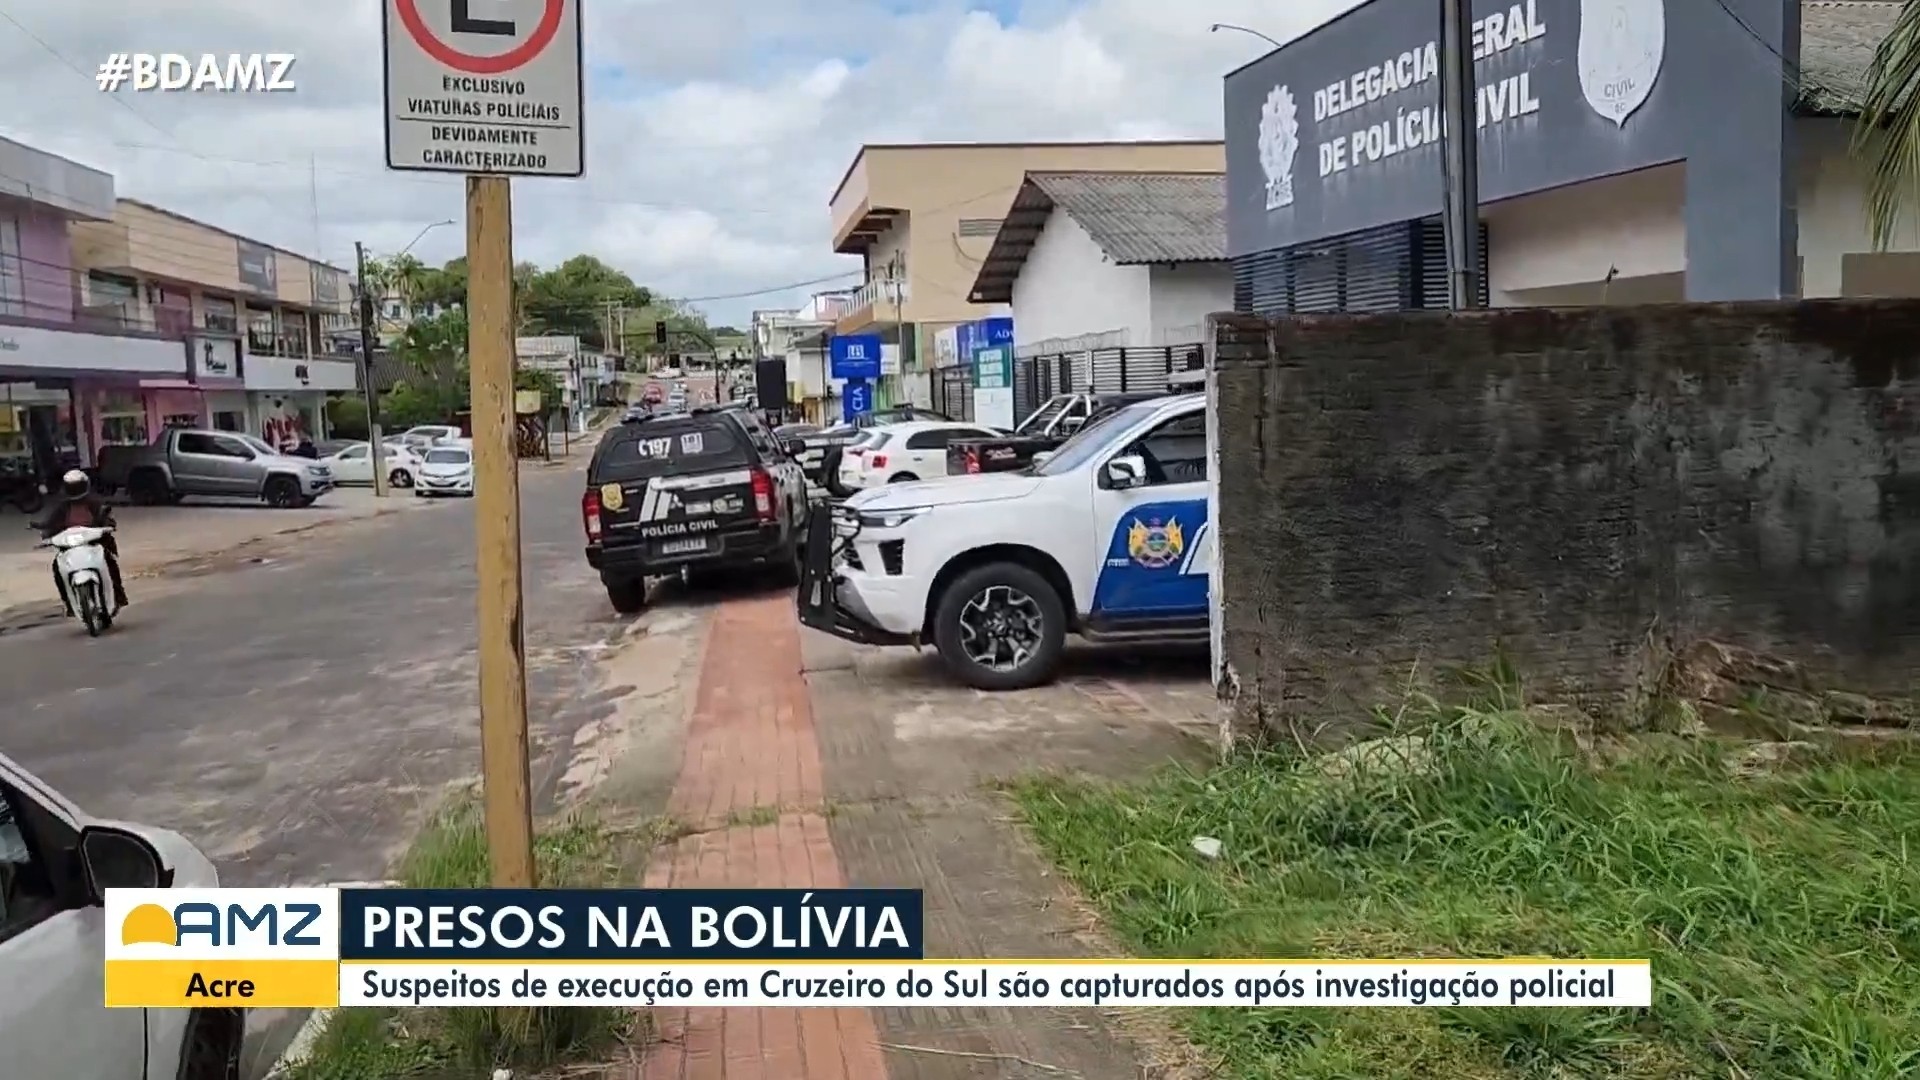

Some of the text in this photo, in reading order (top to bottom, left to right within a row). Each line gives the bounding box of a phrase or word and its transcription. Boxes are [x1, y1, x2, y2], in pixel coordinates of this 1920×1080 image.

[1314, 0, 1546, 123] DELEGACIA ERAL
[442, 75, 526, 96] EXCLUSIVO
[1604, 79, 1635, 98] CIVIL
[407, 97, 482, 116] VIATURAS
[1319, 136, 1348, 177] DE
[1476, 72, 1540, 129] IVIL
[431, 126, 538, 146] DEVIDAMENTE
[423, 149, 548, 169] CARACTERIZADO
[638, 437, 672, 457] C197
[688, 519, 719, 533] CIVIL
